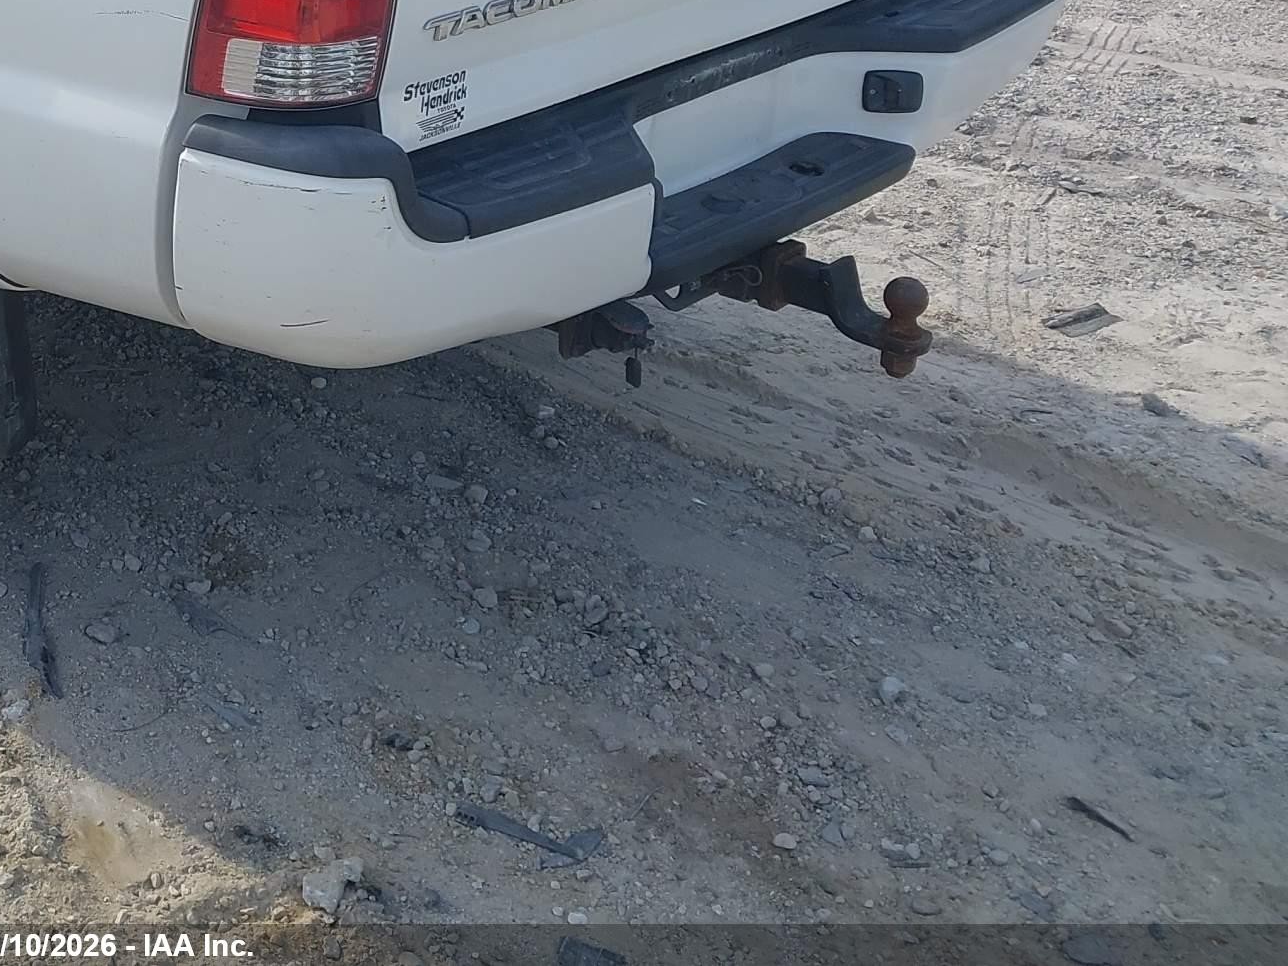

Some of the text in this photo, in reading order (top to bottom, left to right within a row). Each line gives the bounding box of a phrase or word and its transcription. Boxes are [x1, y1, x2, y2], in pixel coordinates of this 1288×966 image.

[403, 69, 467, 102] Stevenson
[420, 82, 468, 117] Hendrick
[437, 102, 457, 114] TOYOTA
